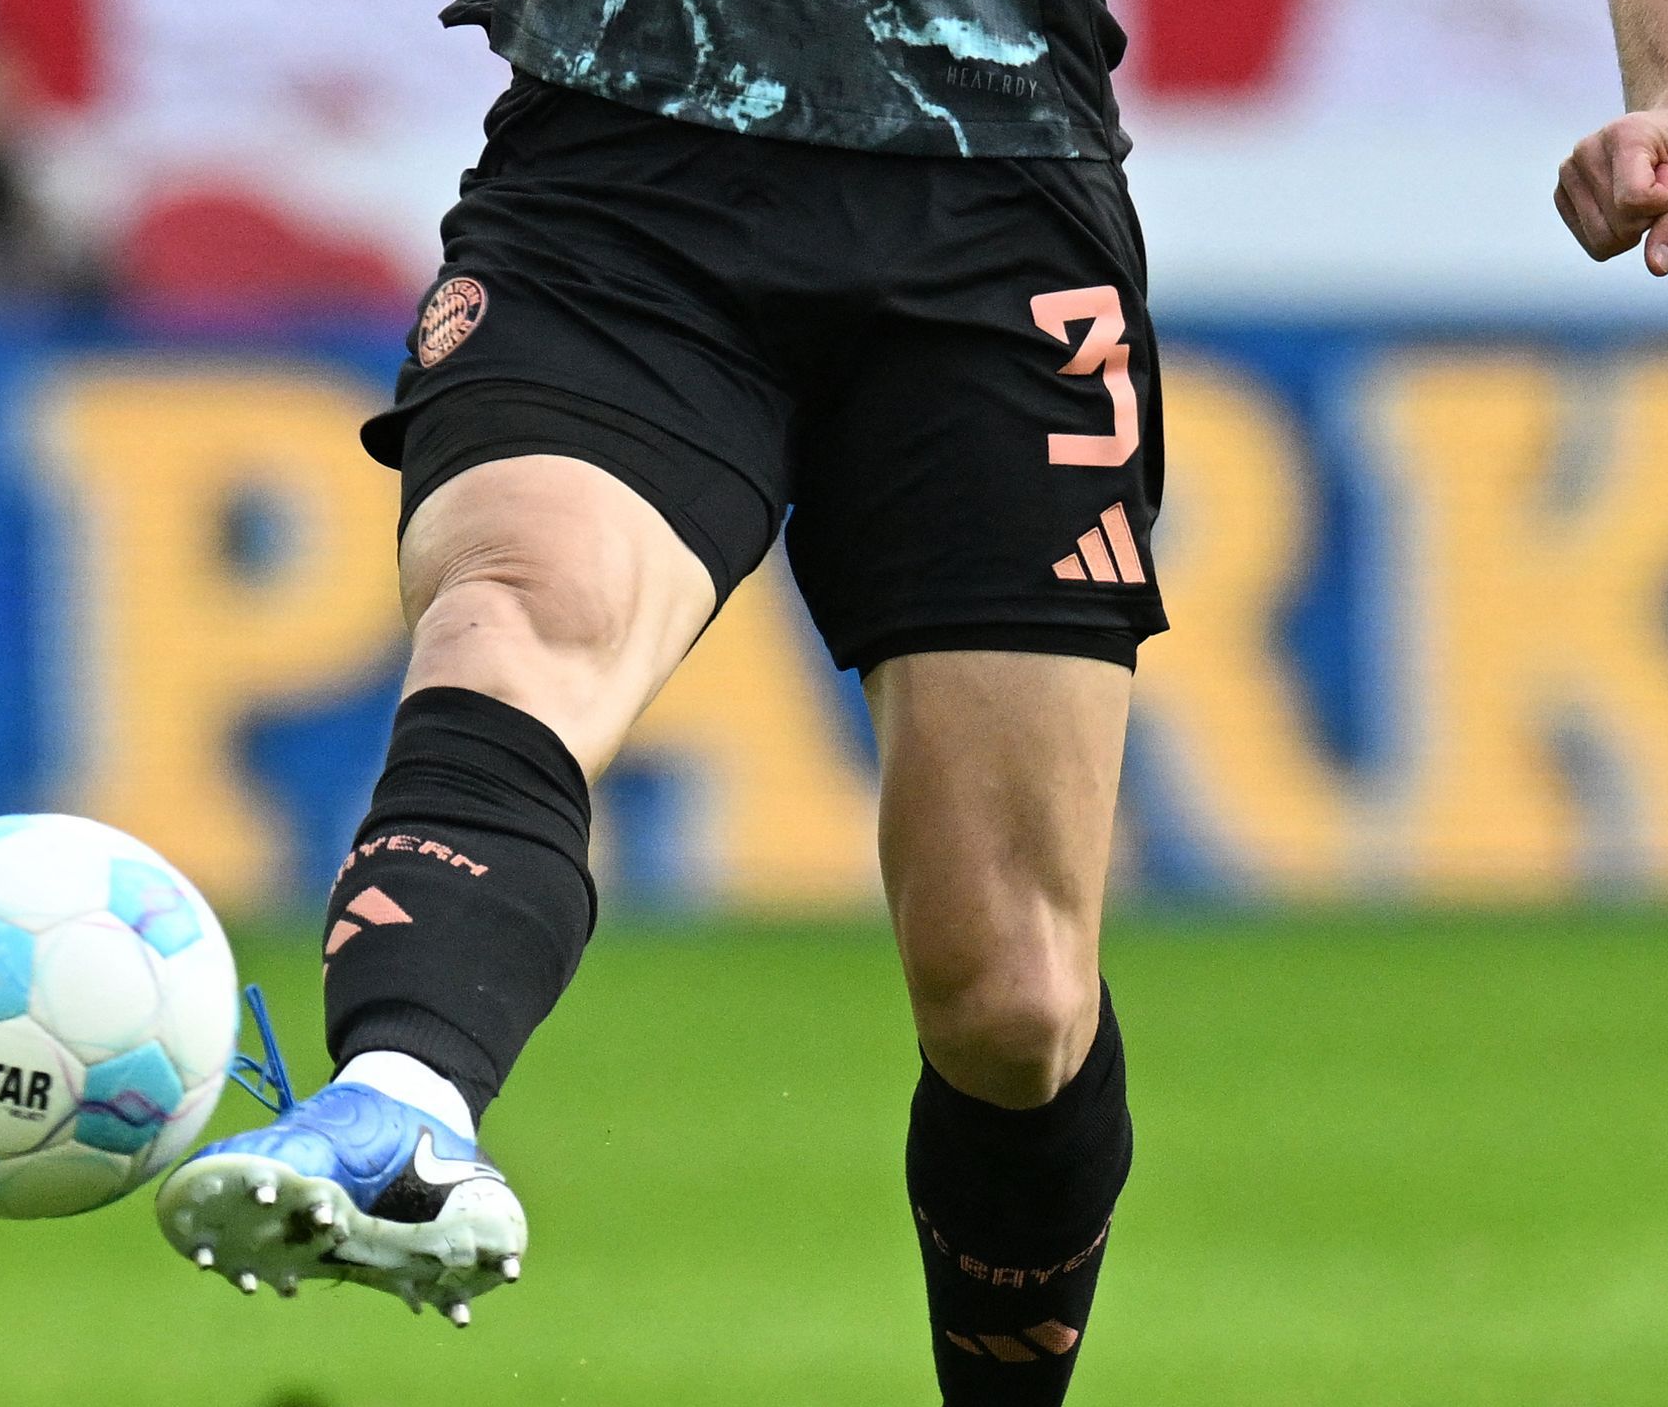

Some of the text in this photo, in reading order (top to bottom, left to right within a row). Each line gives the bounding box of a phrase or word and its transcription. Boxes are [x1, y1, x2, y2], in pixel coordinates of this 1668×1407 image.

[946, 65, 1038, 99] HEAT.RDY
[1030, 285, 1140, 467] 3
[332, 835, 490, 889] AYERN
